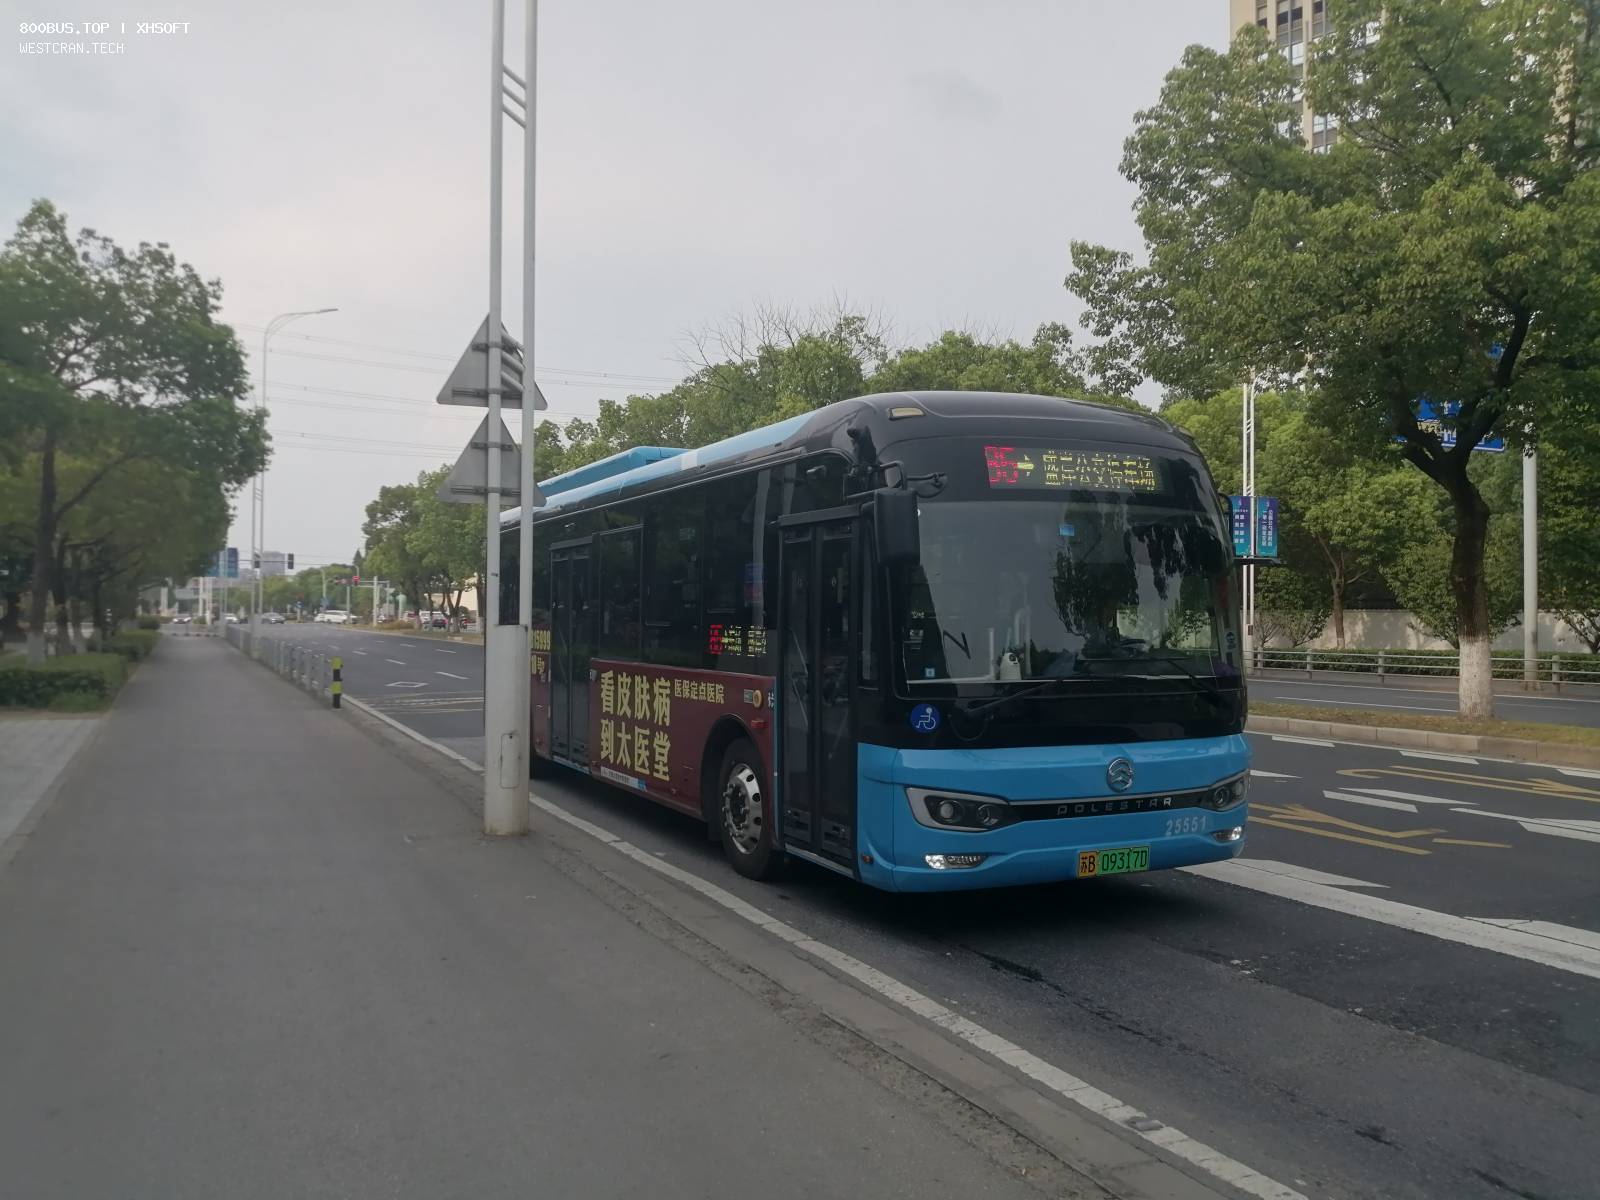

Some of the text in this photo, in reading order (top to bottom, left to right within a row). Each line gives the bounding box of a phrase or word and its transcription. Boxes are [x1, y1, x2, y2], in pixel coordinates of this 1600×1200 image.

[600, 670, 671, 727] 看皮肤病
[674, 679, 725, 704] 医保定点医院
[600, 719, 671, 781] 到太医堂
[1057, 797, 1172, 816] POLESTAR
[1166, 815, 1207, 836] 25551
[1101, 849, 1148, 872] 09317D
